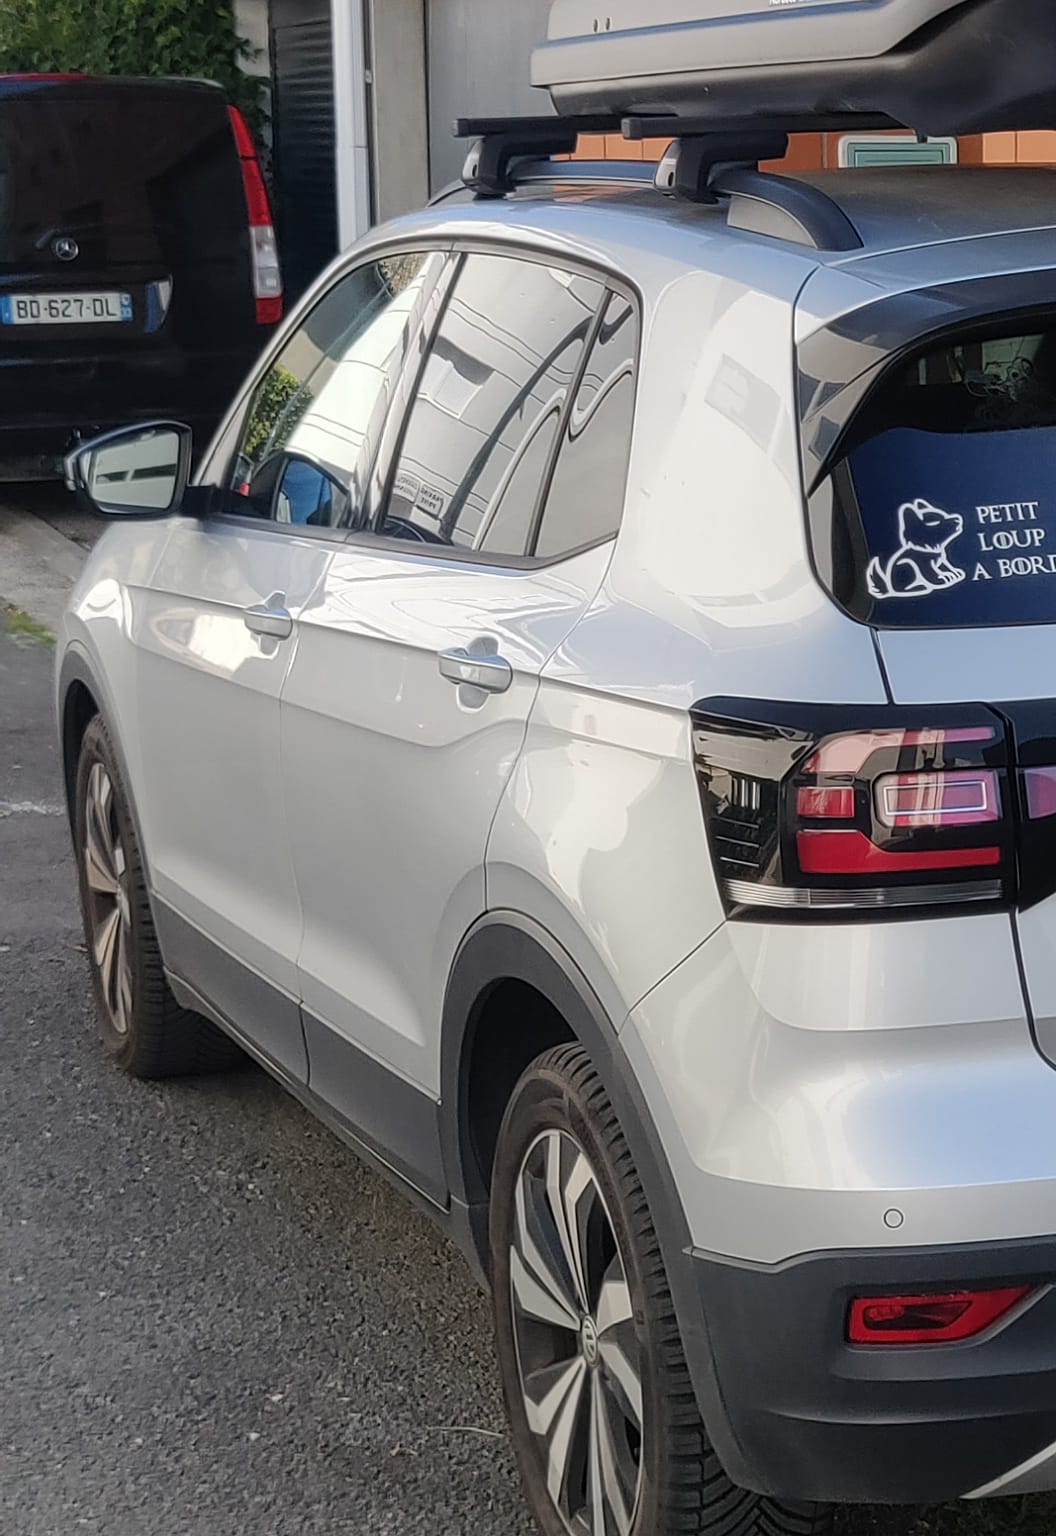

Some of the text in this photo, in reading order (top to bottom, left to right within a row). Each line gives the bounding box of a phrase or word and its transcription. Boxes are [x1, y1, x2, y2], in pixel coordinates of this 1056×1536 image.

[17, 298, 117, 319] BD-627-DL
[975, 501, 1039, 524] PETIT
[978, 527, 1046, 552] LOUP
[972, 562, 992, 581] A
